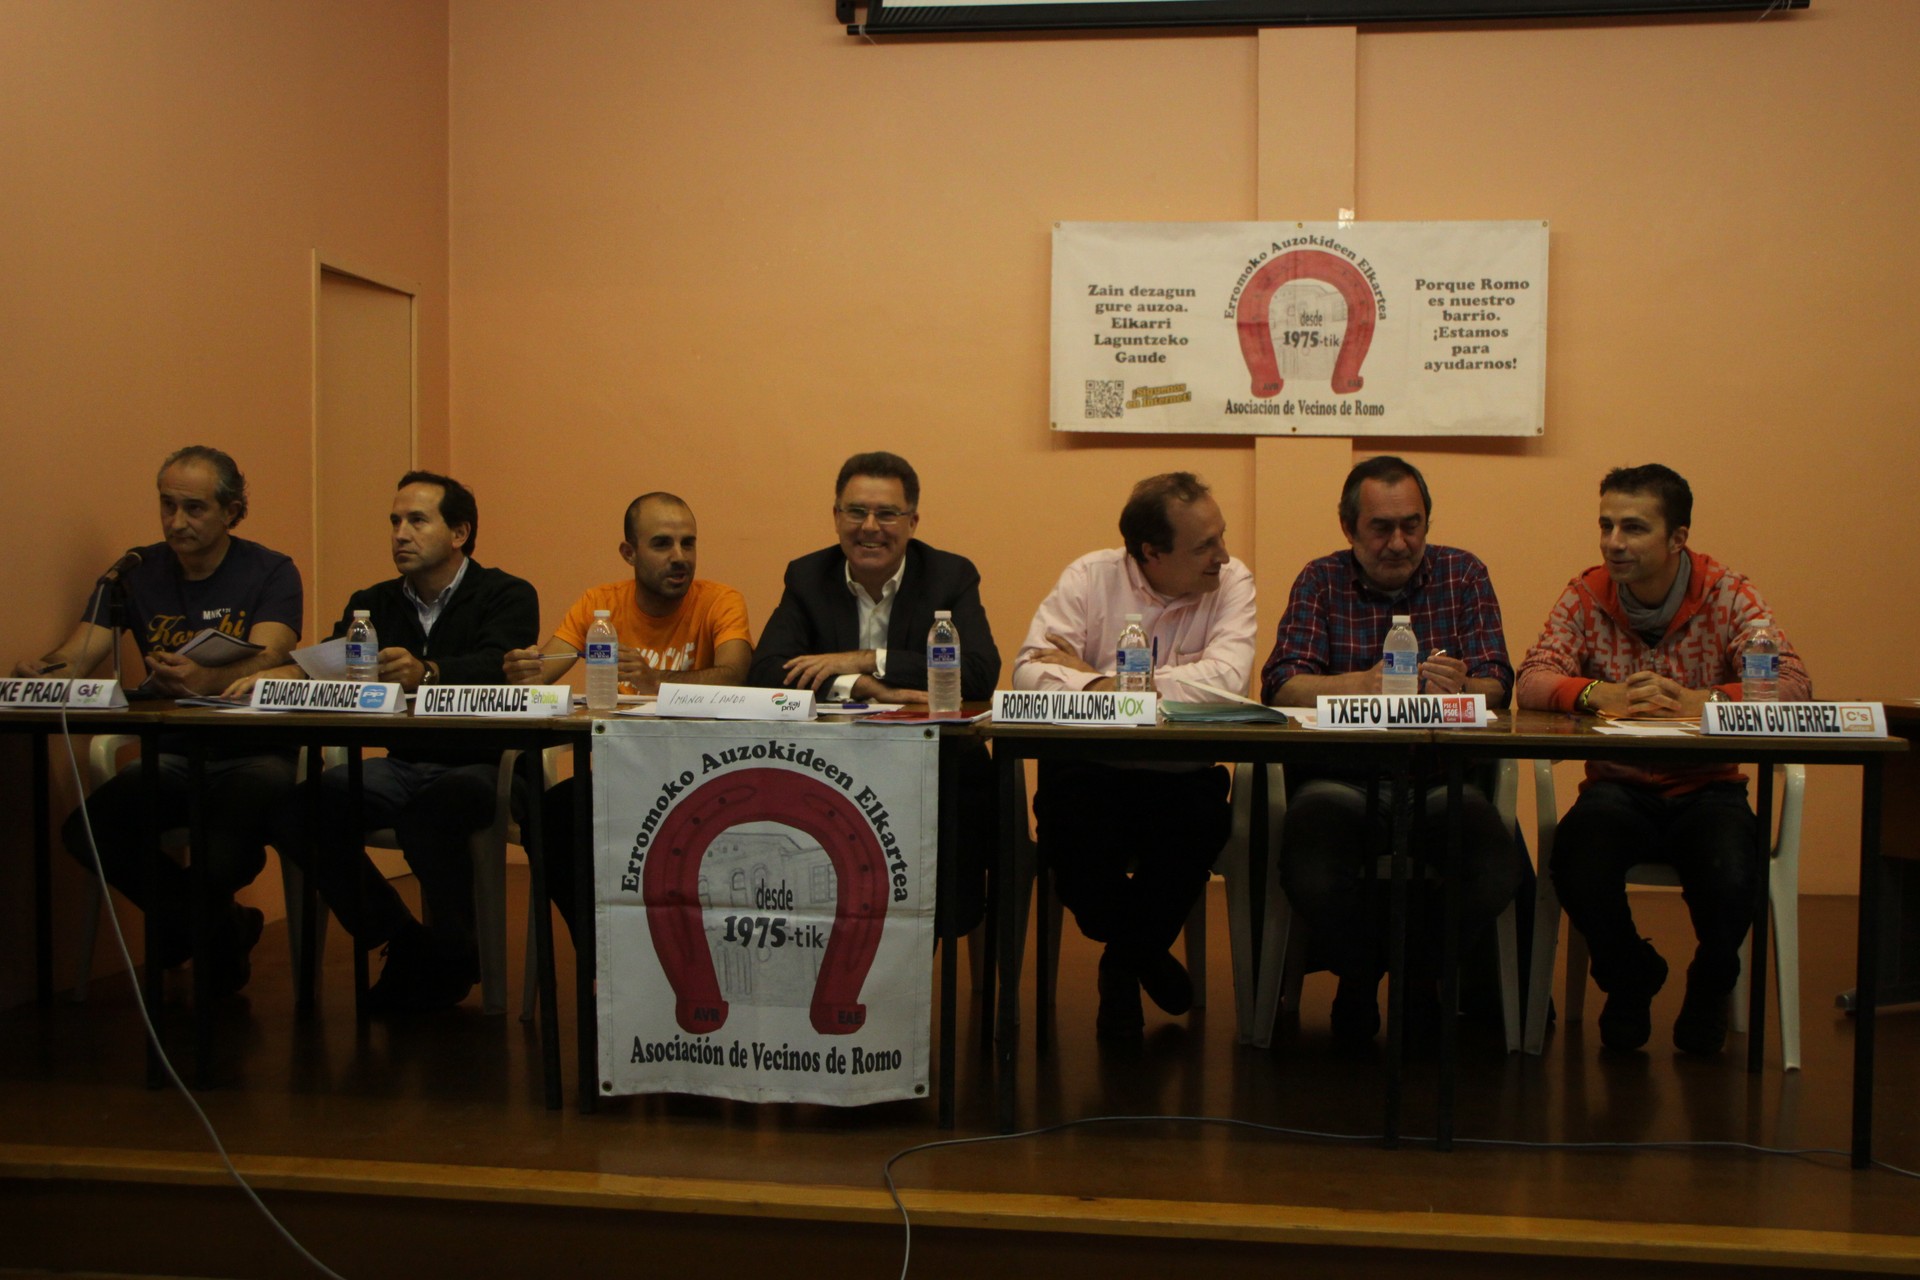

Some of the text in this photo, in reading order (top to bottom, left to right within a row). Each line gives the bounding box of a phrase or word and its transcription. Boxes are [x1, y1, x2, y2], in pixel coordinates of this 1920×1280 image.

[1224, 235, 1387, 320] Erromoko Auzokideen Elkartea
[1415, 278, 1530, 293] Porque Romo
[1088, 284, 1196, 300] Zain dezagun
[1095, 302, 1188, 315] gure auzoa.
[1428, 295, 1515, 307] es nuestro
[1111, 317, 1171, 329] Elkarri
[1300, 309, 1323, 326] desde
[1442, 309, 1500, 321] barrio.
[1094, 333, 1189, 348] Laguntzeko
[1283, 331, 1340, 347] 1975-tik
[1433, 326, 1509, 341] ¡Estamos
[1115, 351, 1166, 363] Gaude
[1451, 344, 1490, 357] para
[1424, 357, 1517, 372] ayudarnos!
[1224, 398, 1385, 416] Asociación de Vecinos de Romo
[0, 682, 22, 702] KE
[260, 681, 361, 708] EDUARDO ANDRADE
[425, 688, 529, 712] OIER ITURRALDE
[1002, 693, 1116, 720] RODRIGO VILALLONGA
[1328, 697, 1442, 723] TXEFO LANDA
[1444, 708, 1458, 717] PSOE
[1717, 705, 1840, 732] RUBEN GUTIERREZ
[1846, 711, 1869, 721] C's
[621, 740, 909, 902] Erromoko Auzokideen Elkartea
[756, 878, 793, 911] desde
[723, 916, 824, 948] 1975-tik
[693, 1007, 720, 1022] AVR
[837, 1010, 863, 1025] EAE
[630, 1034, 902, 1074] Asociación de Vecinos de Romo
